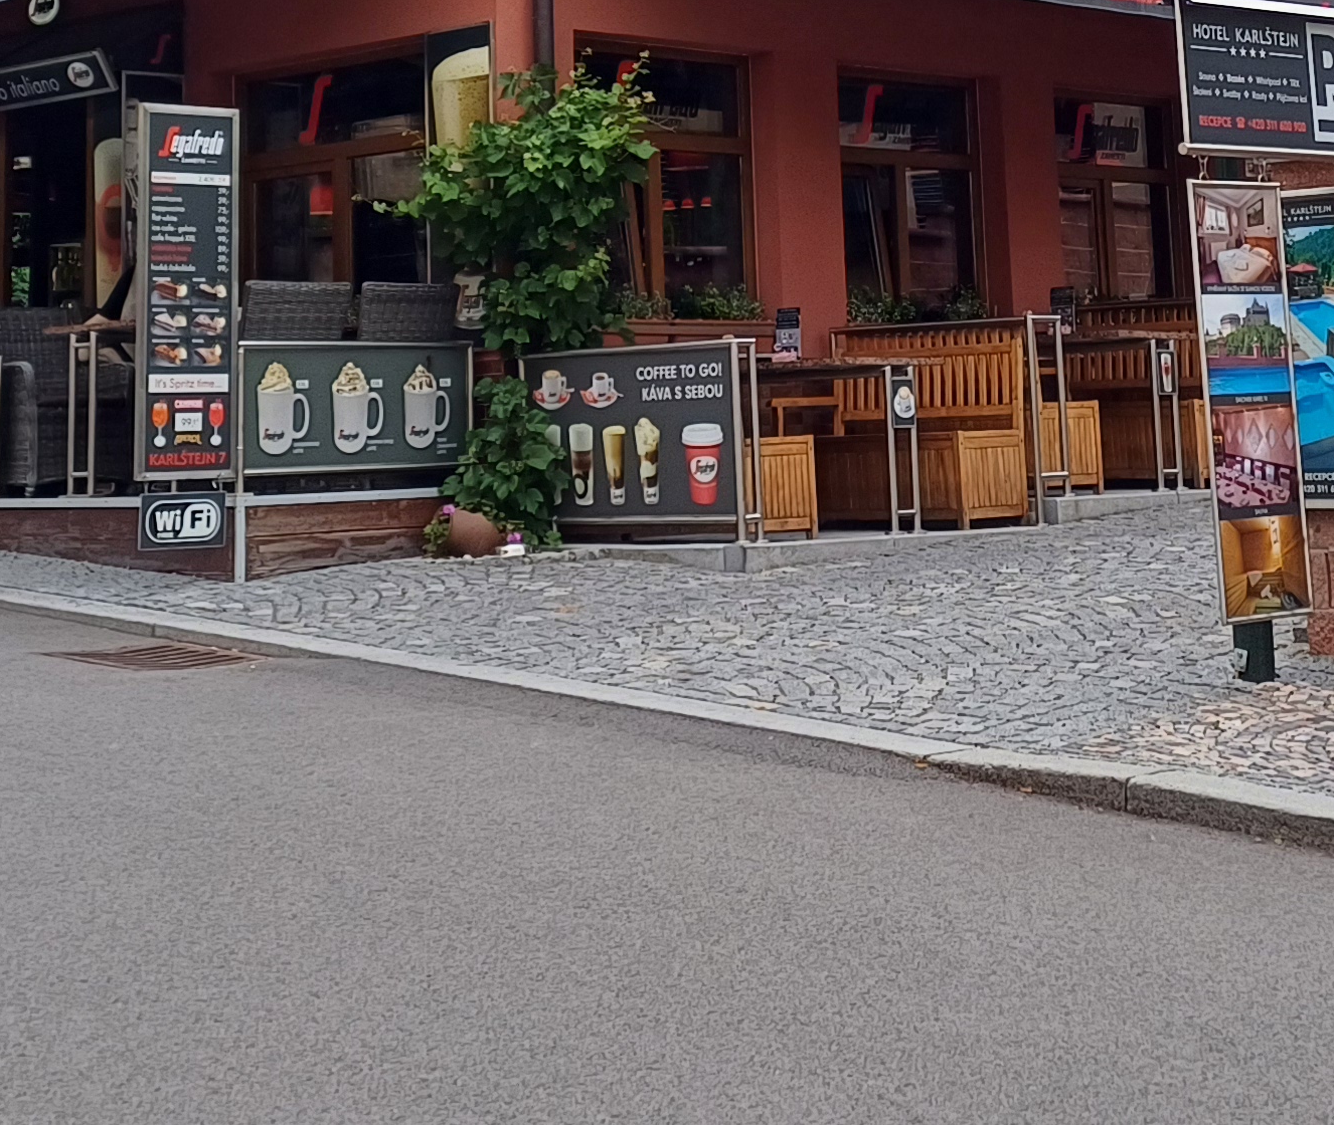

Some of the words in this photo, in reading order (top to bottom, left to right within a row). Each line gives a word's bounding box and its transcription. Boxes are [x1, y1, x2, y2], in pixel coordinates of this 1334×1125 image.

[1192, 23, 1230, 42] HOTEL
[1234, 26, 1300, 48] KARLŠTEJN
[6, 74, 61, 99] italiano
[158, 126, 225, 158] Segafredo
[635, 364, 677, 381] COFFEE
[679, 364, 696, 379] TO
[698, 361, 723, 377] GO!
[641, 383, 672, 402] KÁVA
[674, 385, 683, 400] S
[684, 383, 723, 400] SEBOU
[148, 448, 217, 466] KARLŠTEJN
[217, 451, 227, 464] 7
